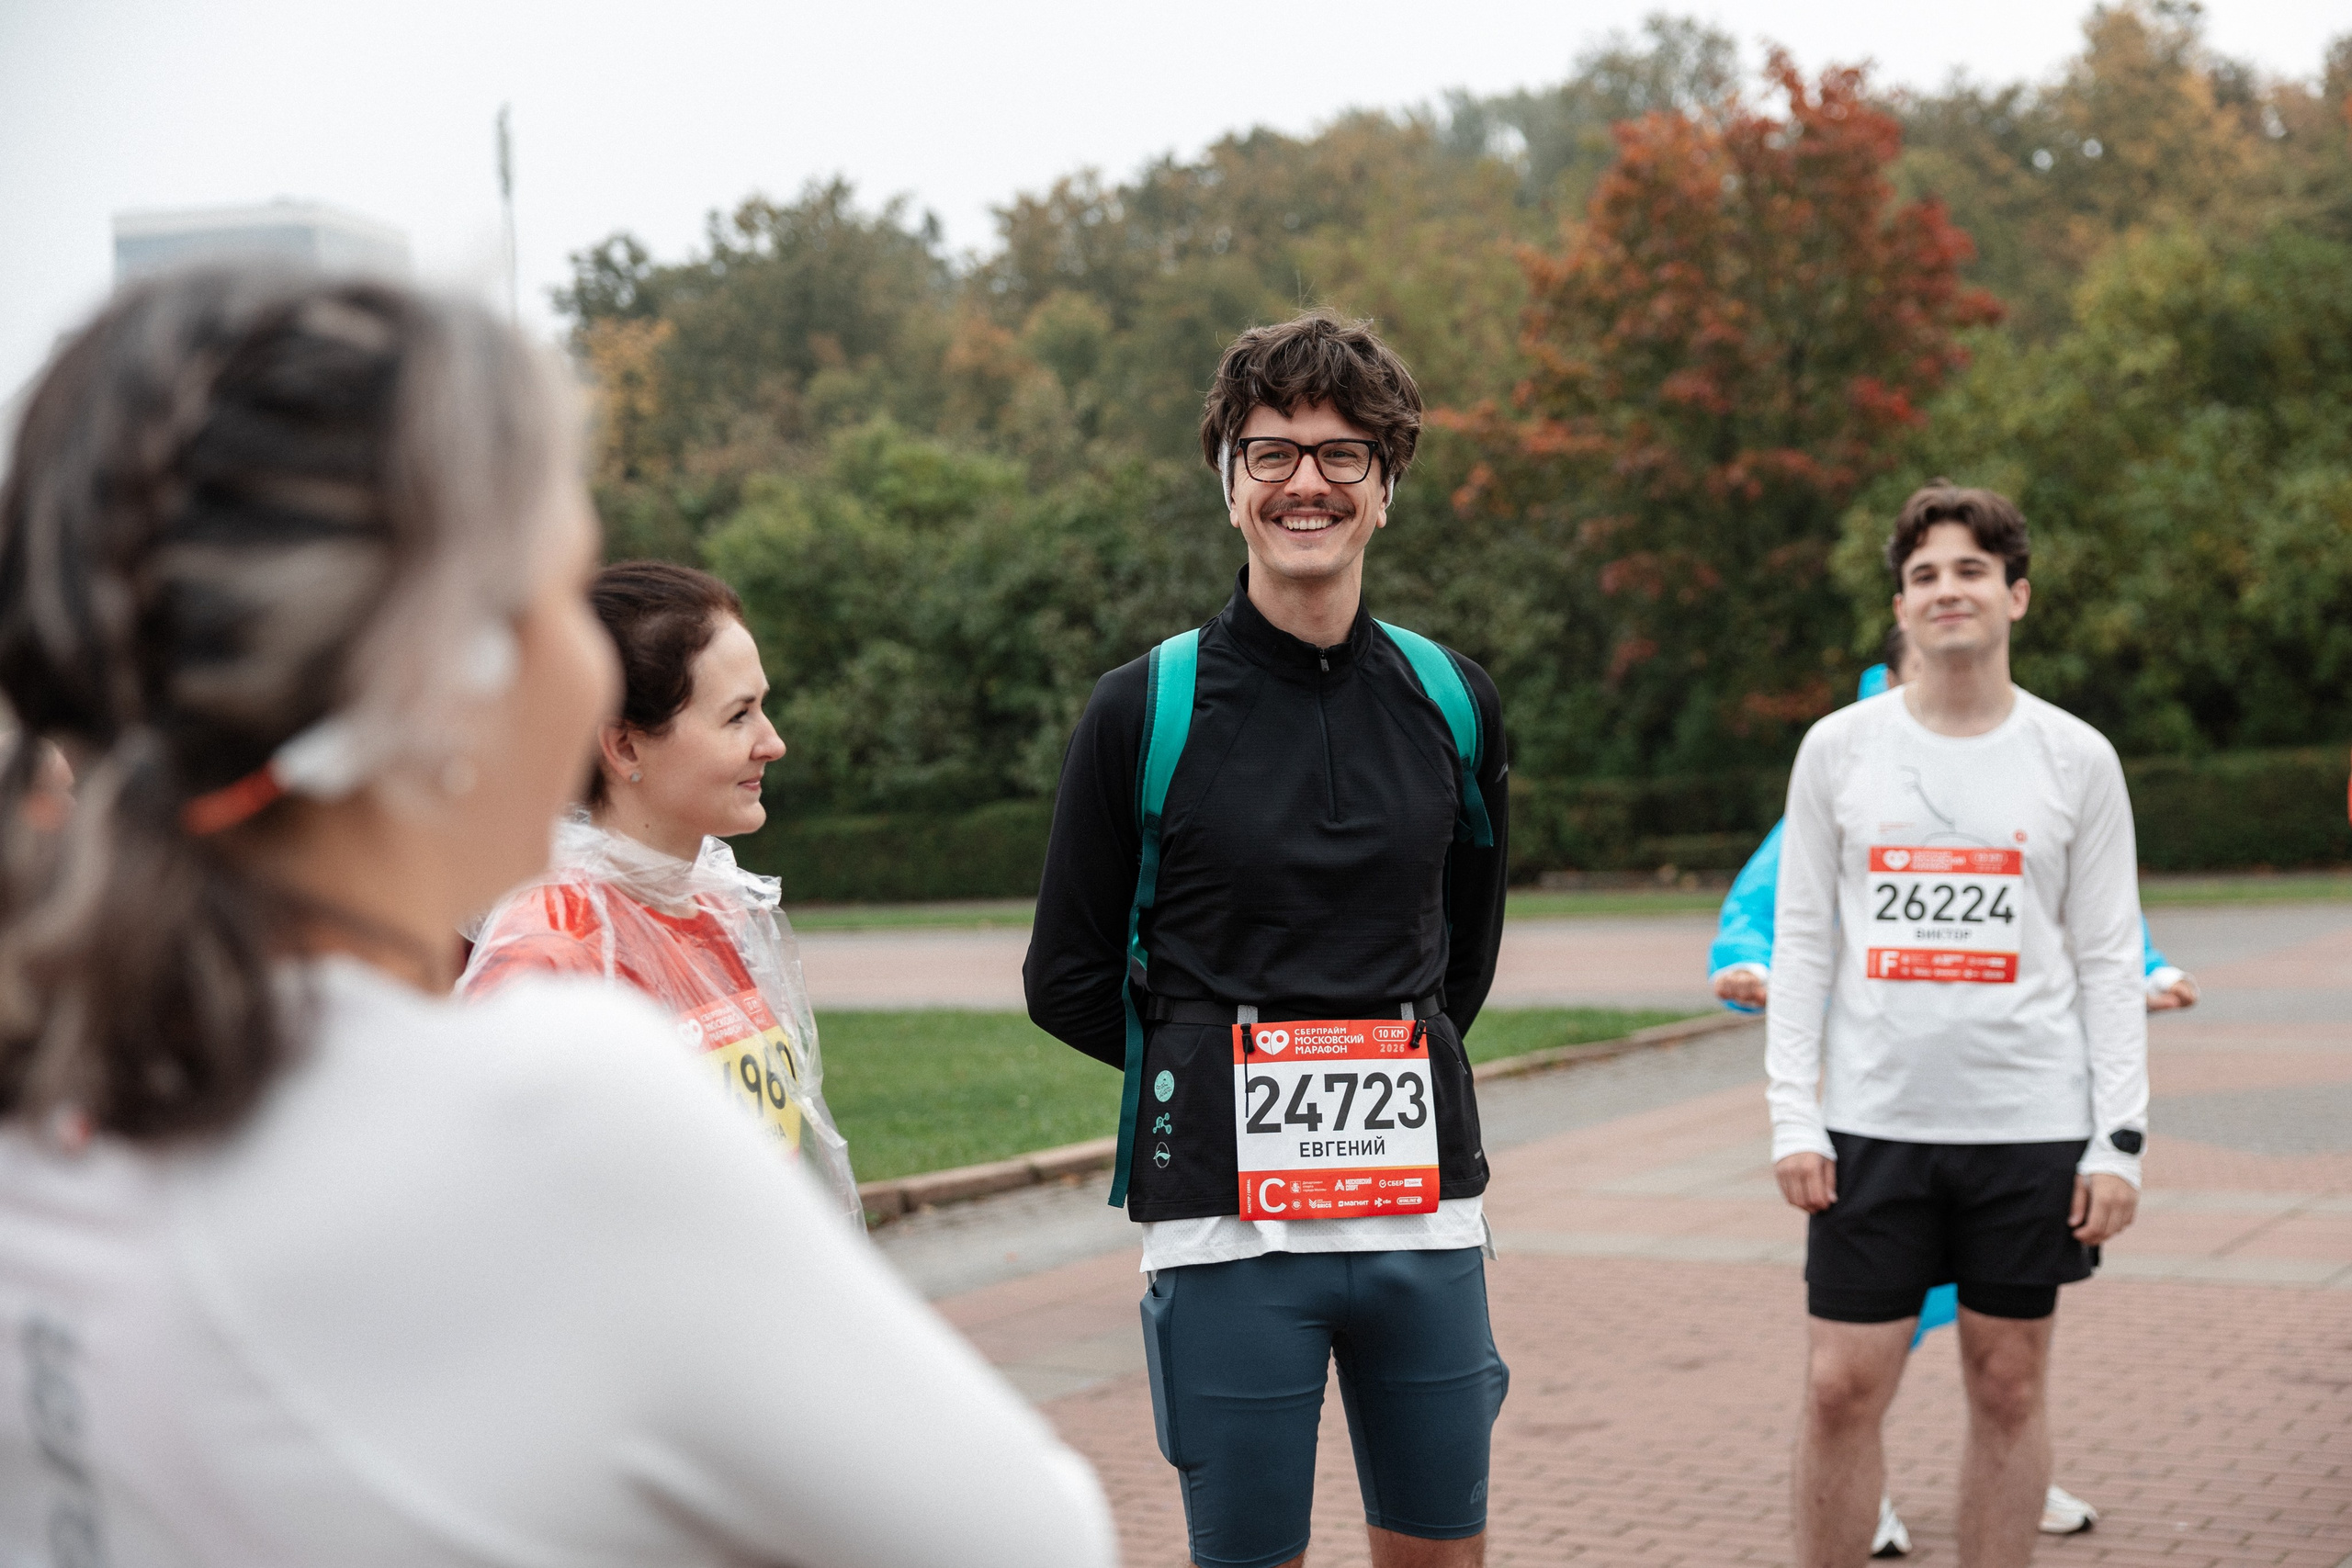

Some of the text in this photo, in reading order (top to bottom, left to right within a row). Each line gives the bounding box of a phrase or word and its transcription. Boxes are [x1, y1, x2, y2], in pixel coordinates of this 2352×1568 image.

[1876, 884, 2015, 923] 26224
[1880, 951, 1900, 976] F
[1295, 1026, 1347, 1036] СБЕРПРАЙМ
[1378, 1029, 1387, 1038] 10
[1295, 1033, 1364, 1045] МОСКОВСКИЙ
[1295, 1044, 1348, 1055] МАРАФОН
[1380, 1043, 1405, 1053] 2026
[1245, 1071, 1428, 1134] 24723
[1299, 1135, 1385, 1157] ЕВГЕНИЙ
